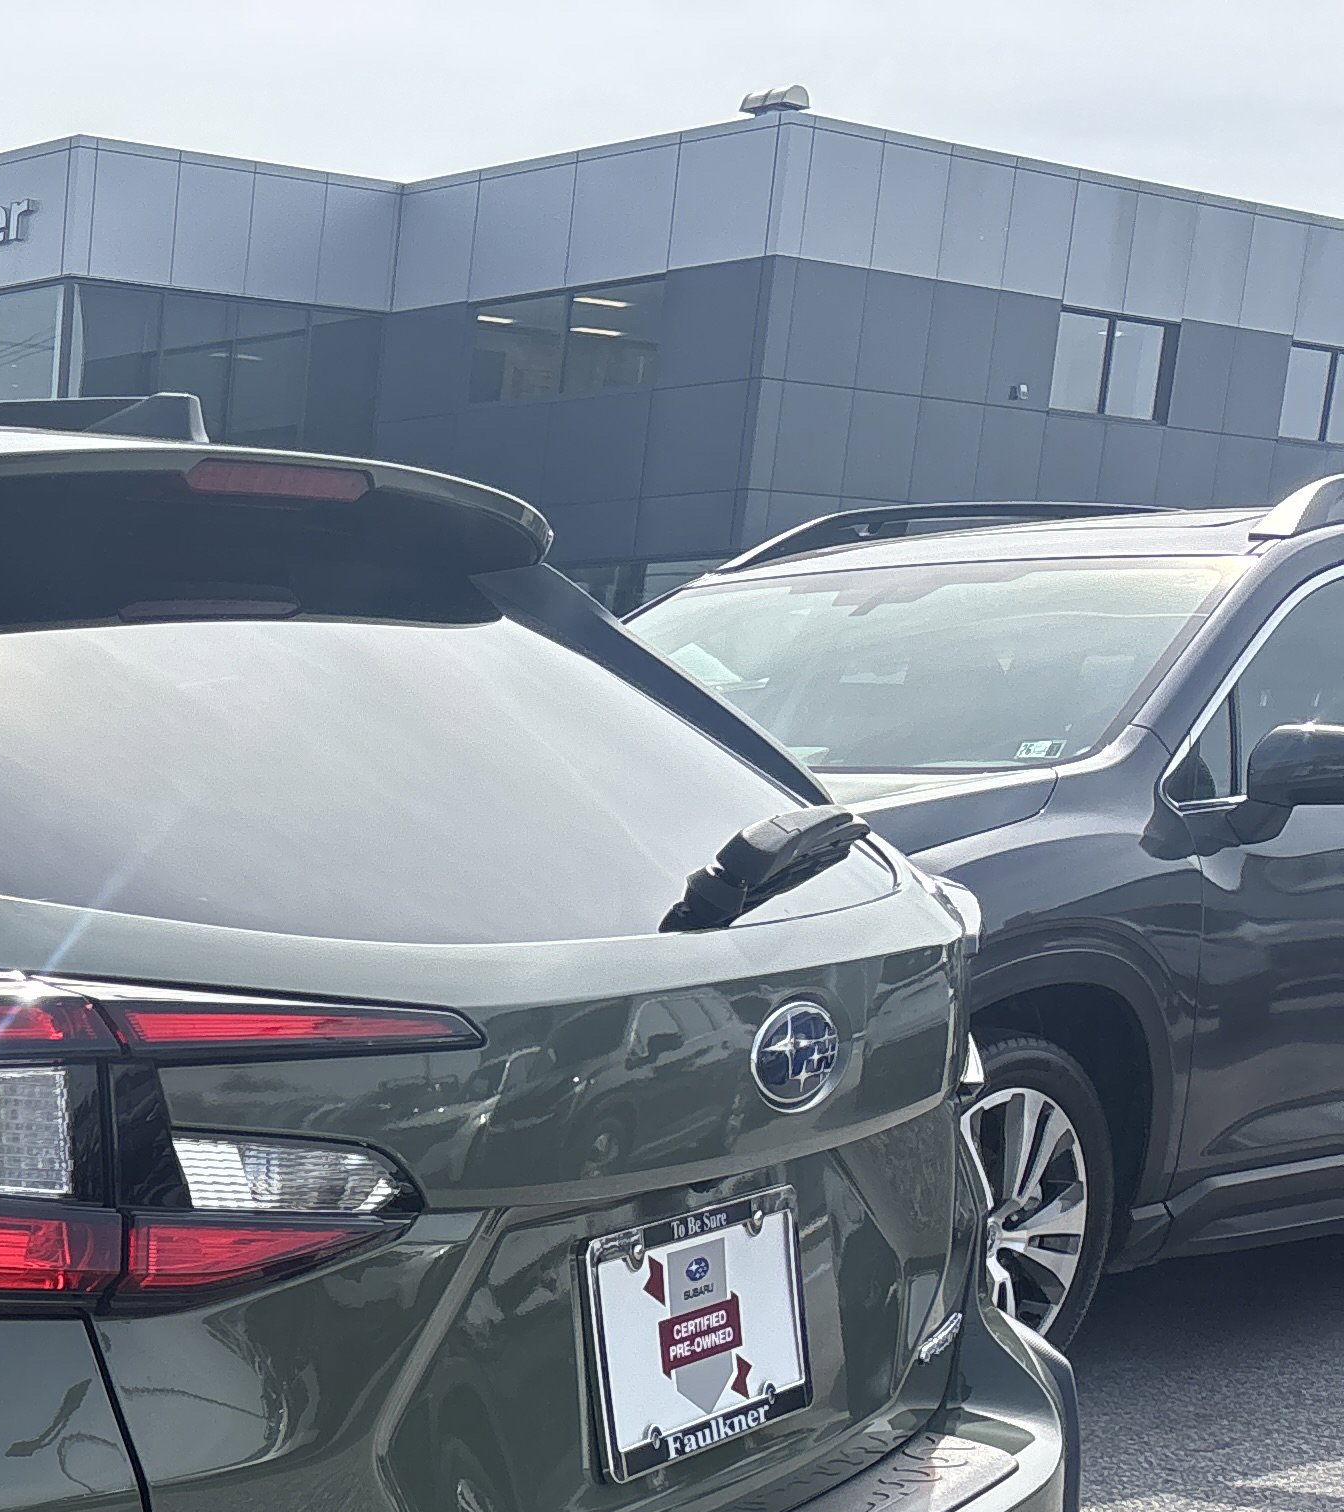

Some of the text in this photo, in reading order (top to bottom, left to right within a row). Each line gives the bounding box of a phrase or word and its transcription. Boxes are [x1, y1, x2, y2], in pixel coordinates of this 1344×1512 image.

[671, 1211, 727, 1239] To Be Sure
[672, 1309, 727, 1340] CERTIFIED
[669, 1326, 734, 1361] PRE-OWNED
[664, 1403, 770, 1460] Faulkner
